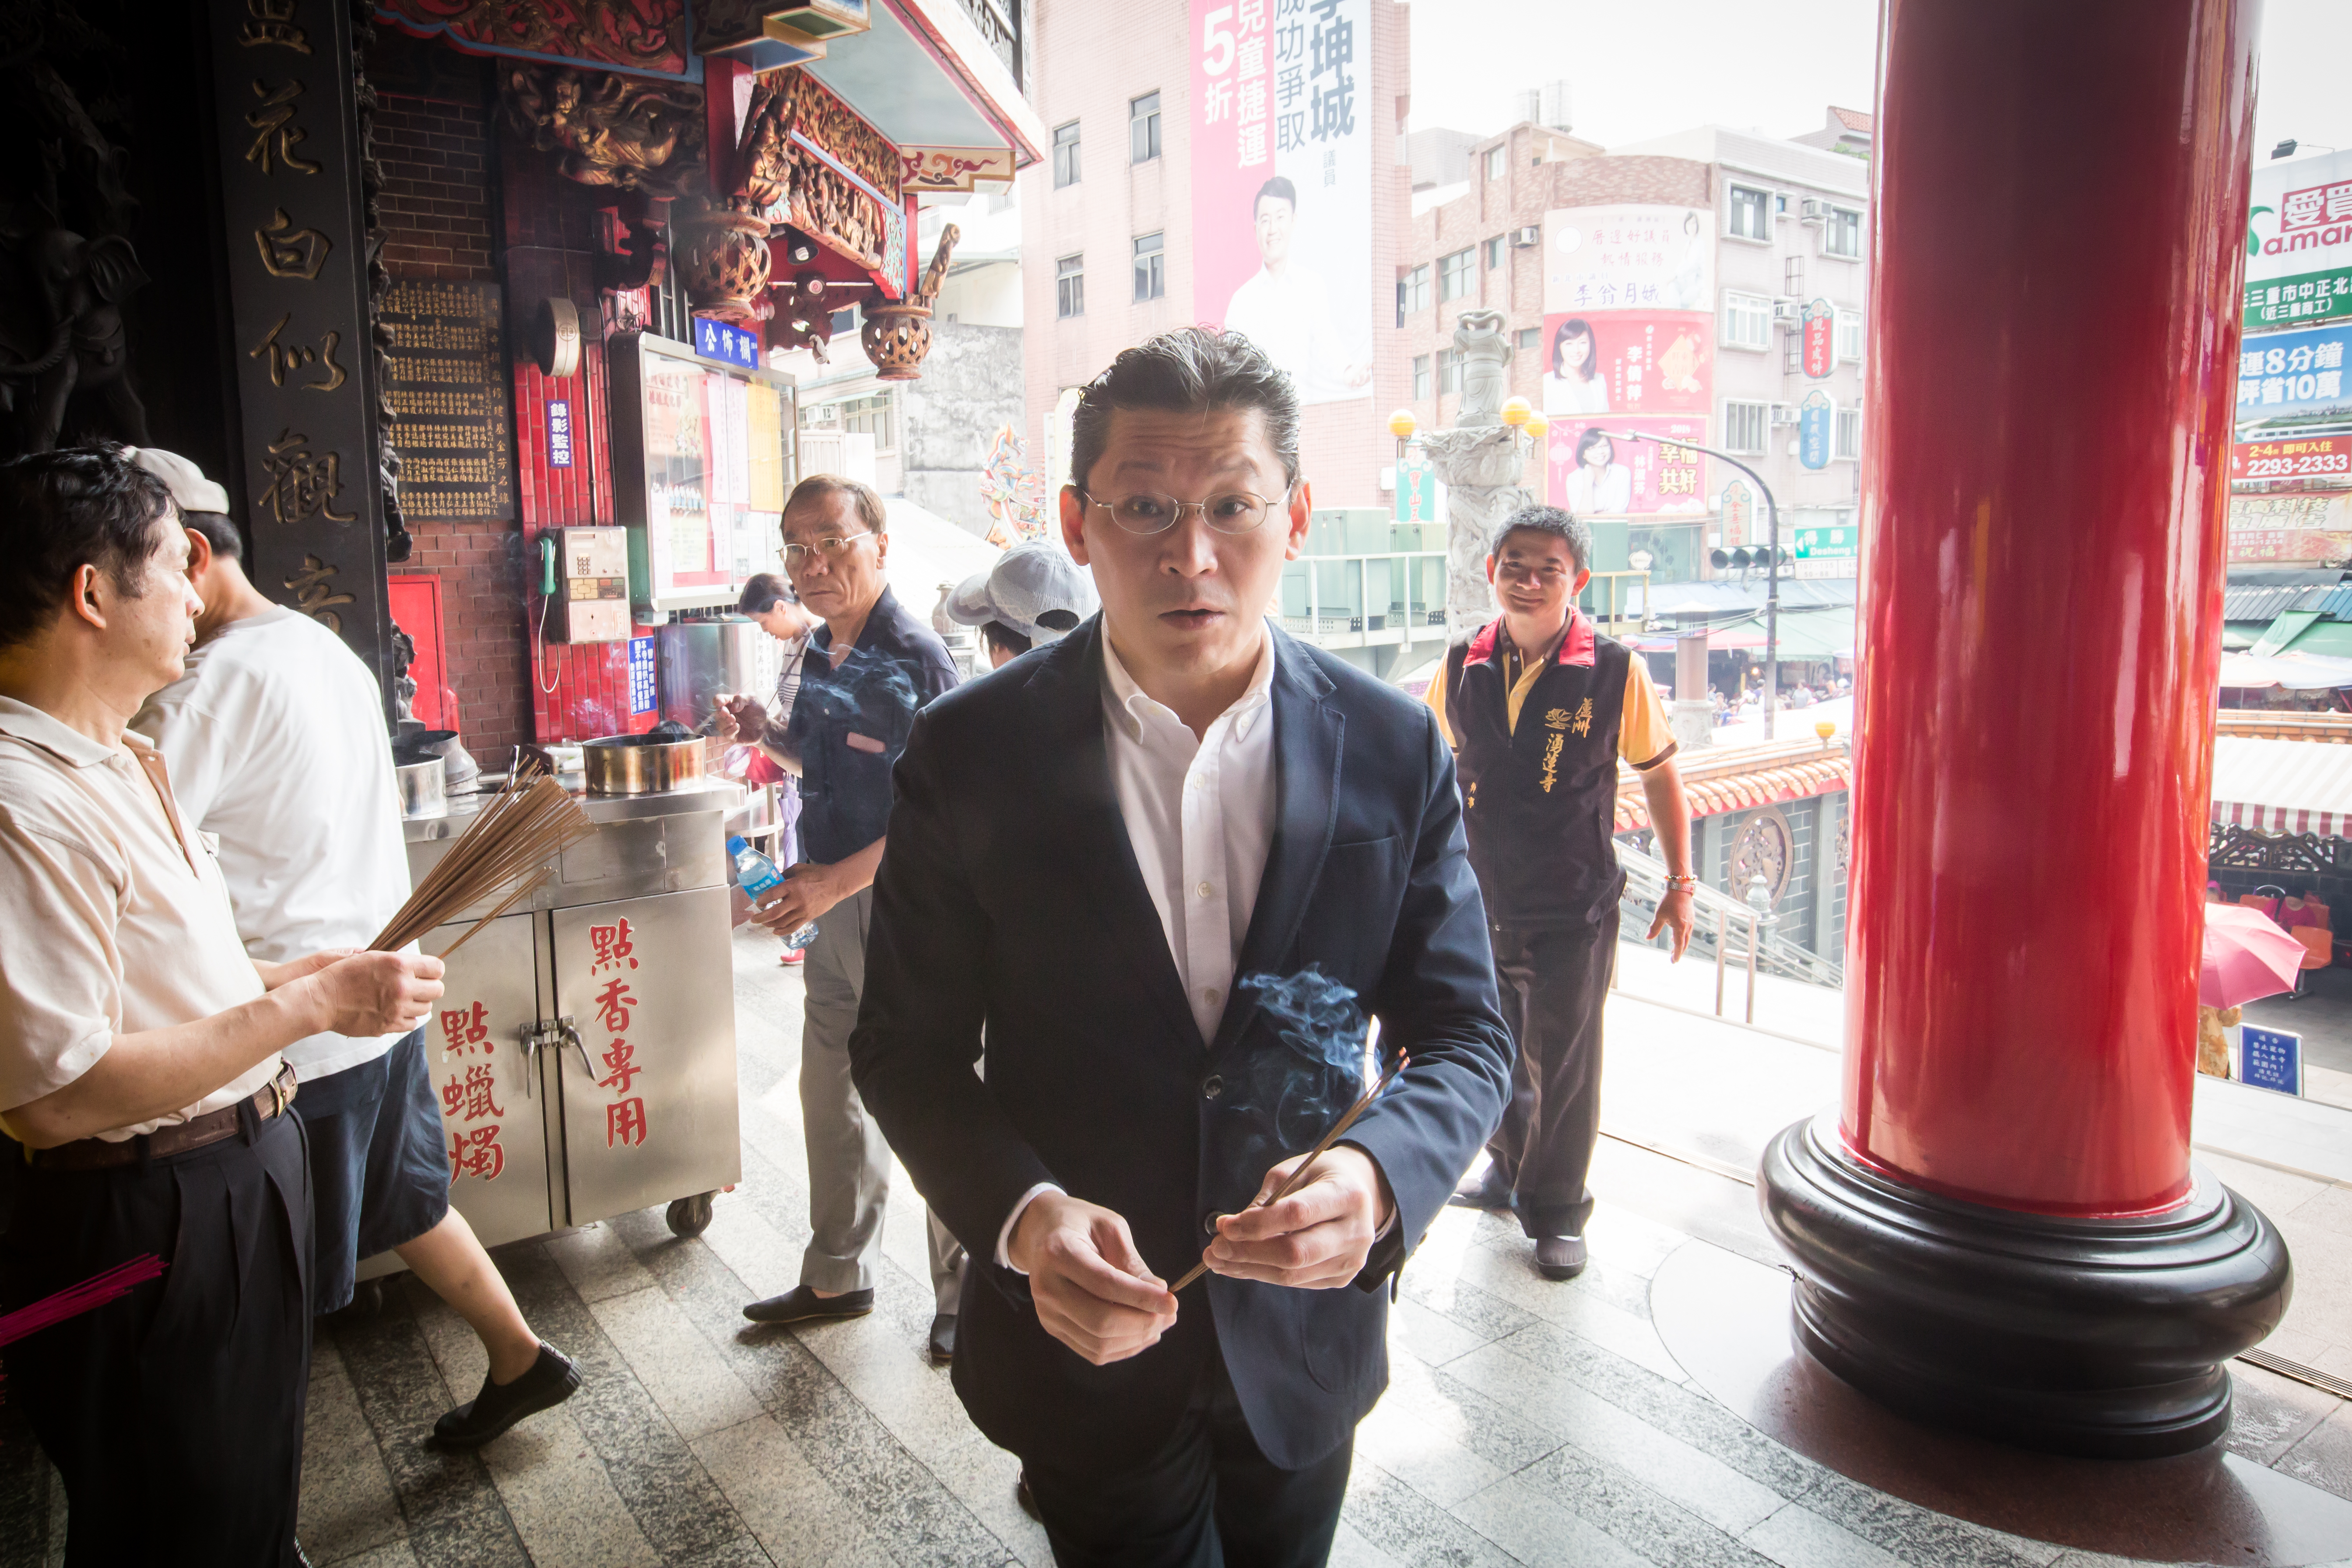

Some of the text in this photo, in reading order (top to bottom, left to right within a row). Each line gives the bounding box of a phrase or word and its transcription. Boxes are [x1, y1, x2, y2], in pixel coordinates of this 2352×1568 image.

[1202, 6, 1235, 125] 5折
[1237, 0, 1267, 169] 兒童捷運
[1323, 149, 1336, 187] 議員
[1600, 251, 1664, 267] 熱情服務
[1574, 282, 1662, 307] 李翁月娥
[2244, 276, 2352, 309] 三重市中正北
[705, 323, 751, 363] 公佈欄
[550, 403, 569, 464] 錄影監控
[1670, 424, 1691, 434] 2018
[2282, 441, 2333, 455] 即可入住
[1634, 455, 1646, 495] 林淑芬
[1658, 467, 1698, 495] 共好
[2247, 454, 2348, 477] 2293-2333
[1408, 471, 1422, 522] 寶山五
[1809, 546, 1851, 556] Desheng
[756, 631, 765, 689] 請勿再沖洗
[1539, 733, 1565, 793] 湧蓮寺
[588, 916, 647, 1149] 點香專用
[440, 1000, 505, 1188] 點蠟燭
